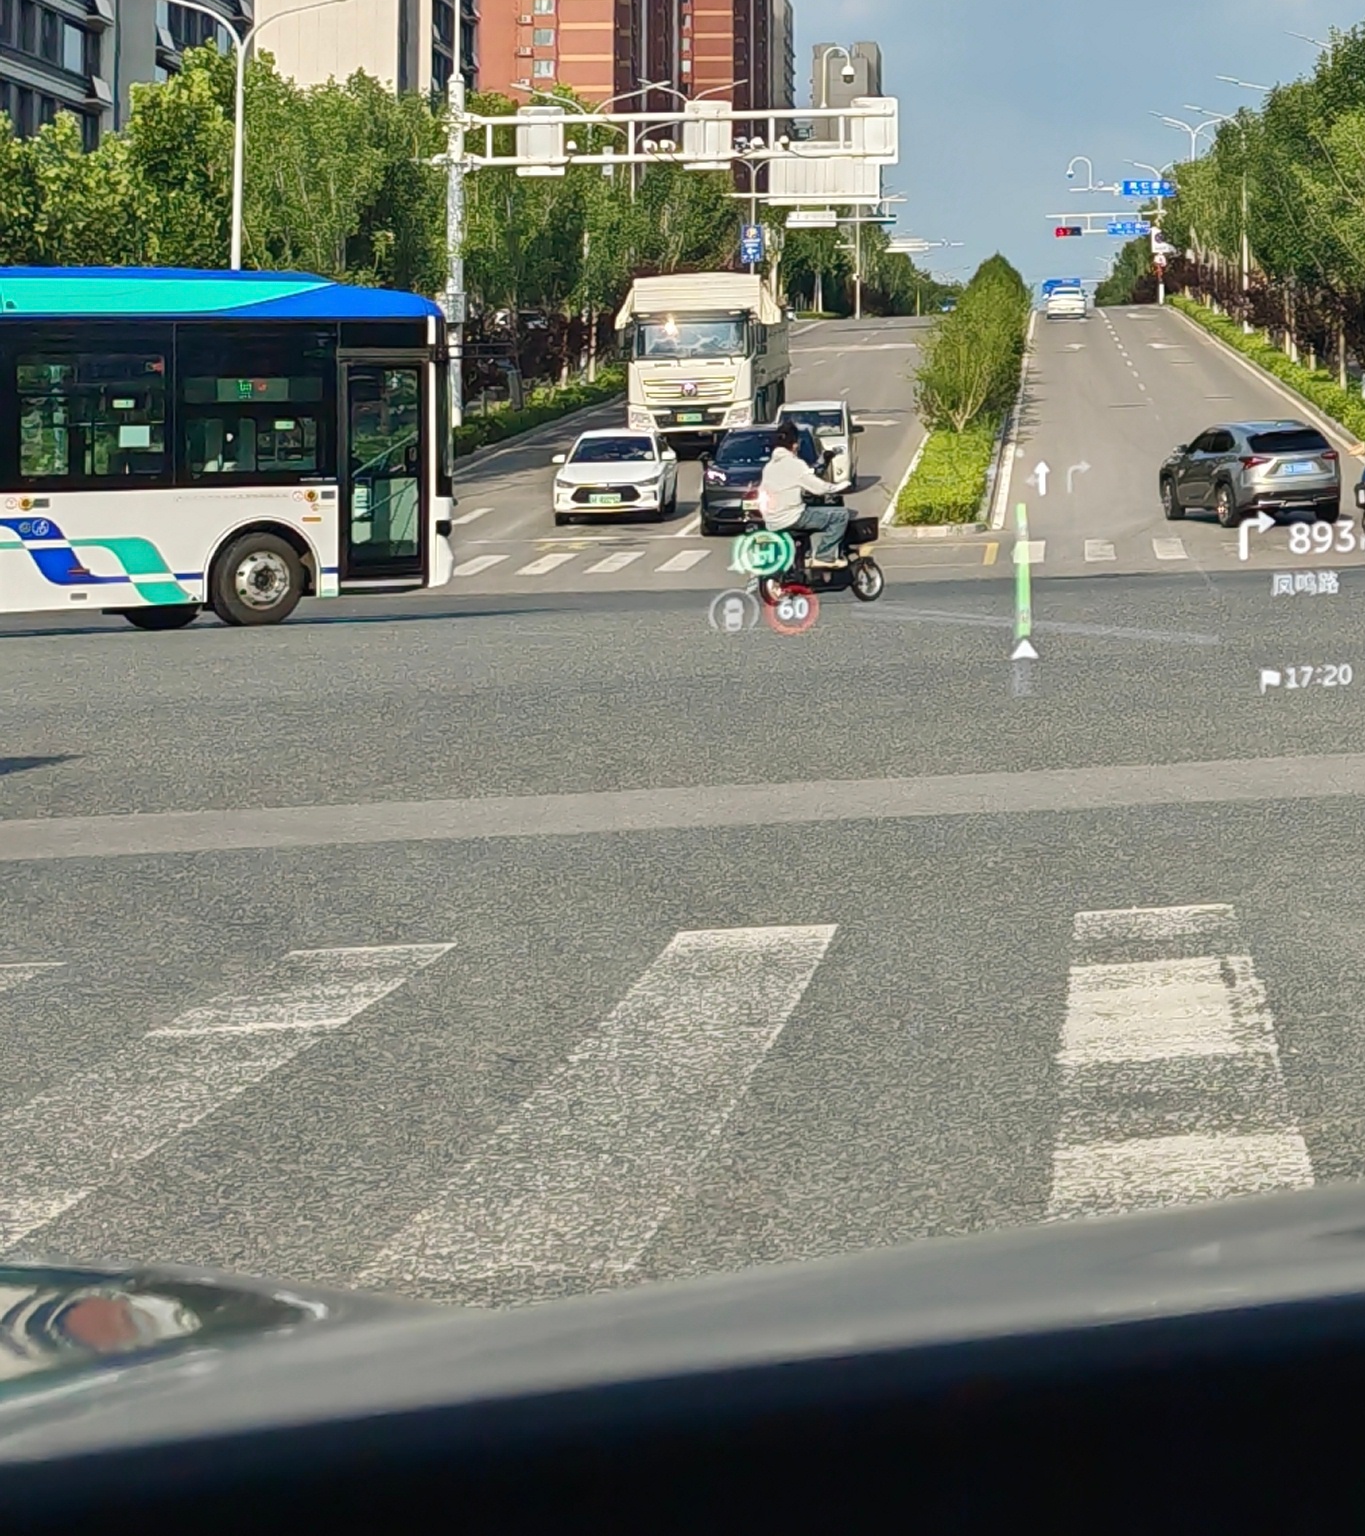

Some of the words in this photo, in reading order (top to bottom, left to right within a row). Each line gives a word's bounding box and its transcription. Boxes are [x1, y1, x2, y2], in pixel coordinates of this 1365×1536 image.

[1288, 520, 1356, 554] 893
[1271, 571, 1339, 596] 凤鸣路
[779, 596, 809, 619] 60
[1285, 664, 1353, 689] 17:20
